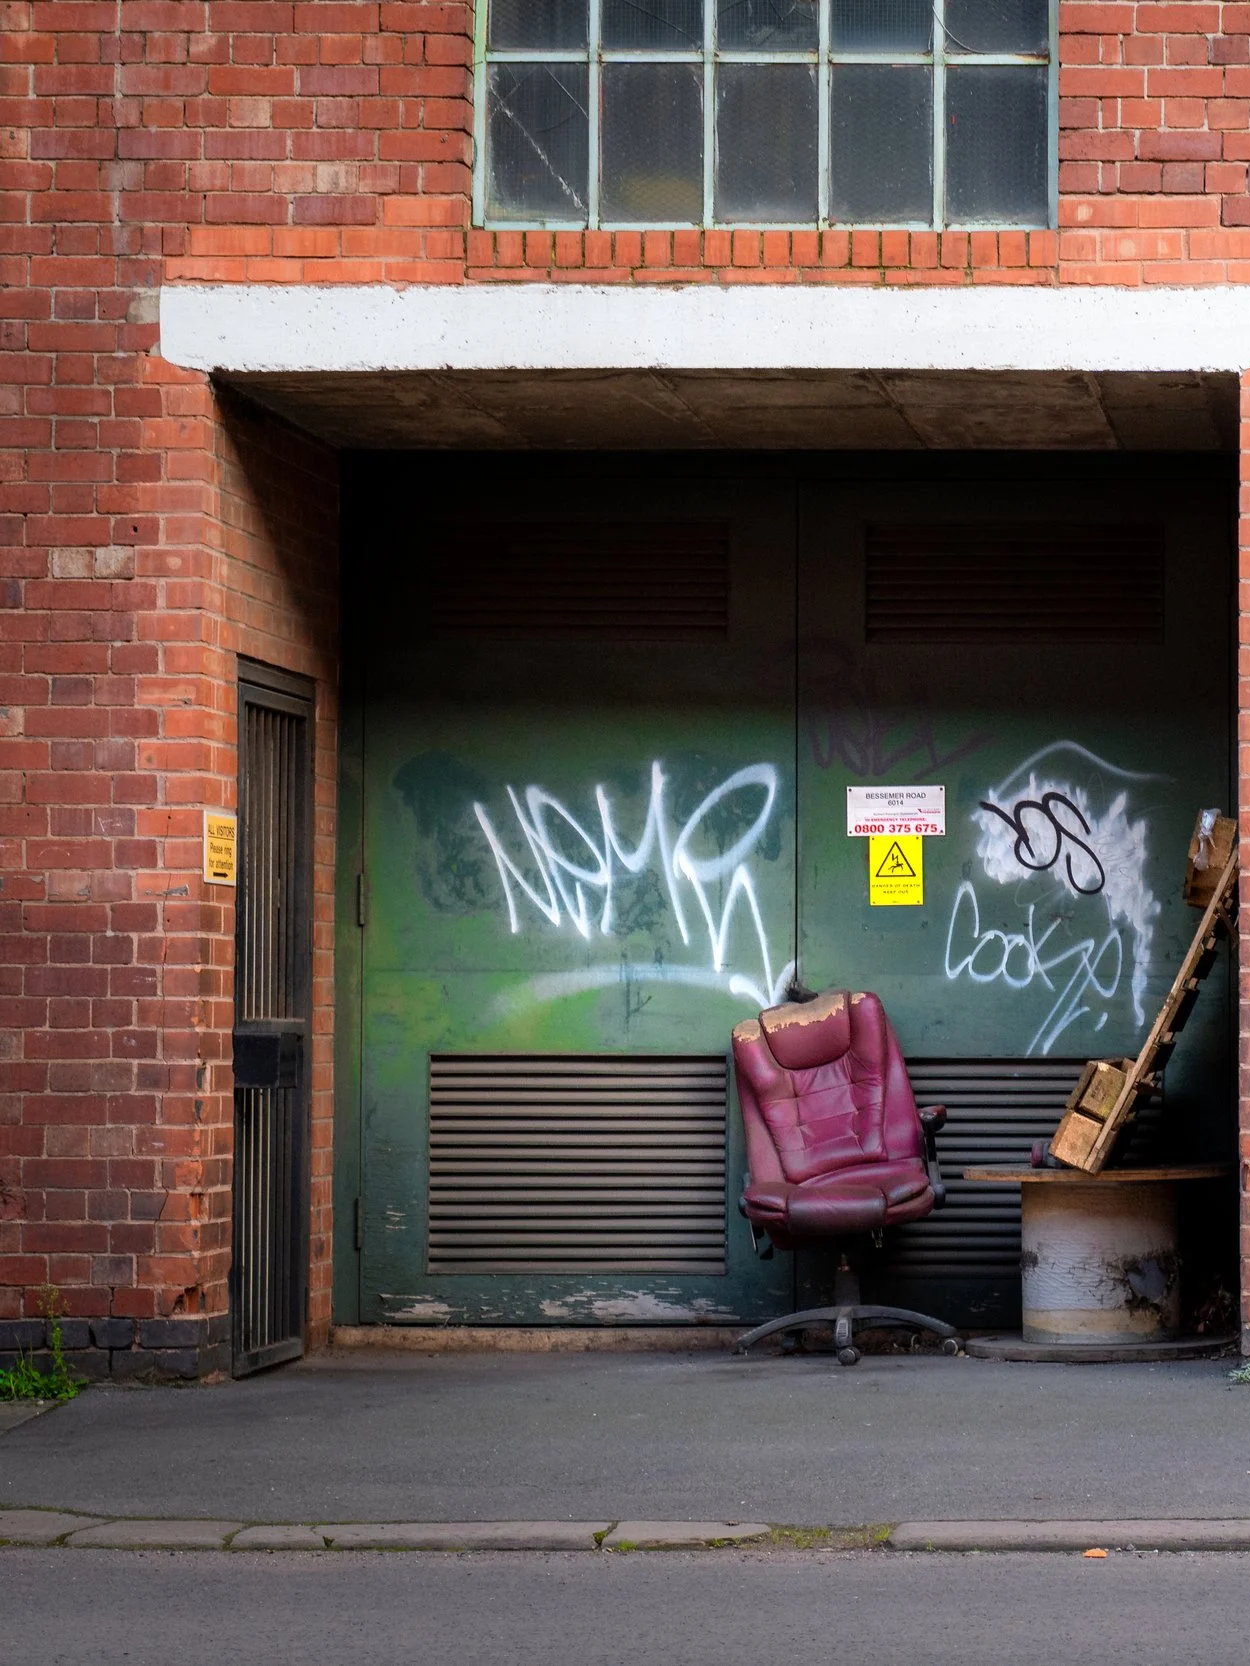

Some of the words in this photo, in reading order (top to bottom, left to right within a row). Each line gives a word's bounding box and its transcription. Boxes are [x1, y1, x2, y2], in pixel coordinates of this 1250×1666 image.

[865, 792, 905, 800] BESSEMER
[905, 791, 927, 799] ROAD
[216, 825, 235, 838] VISITORS
[854, 823, 885, 834] 0800
[888, 823, 911, 833] 375
[914, 823, 938, 833] 675
[210, 842, 224, 856] Please
[224, 845, 232, 858] ring
[215, 858, 233, 871] attention
